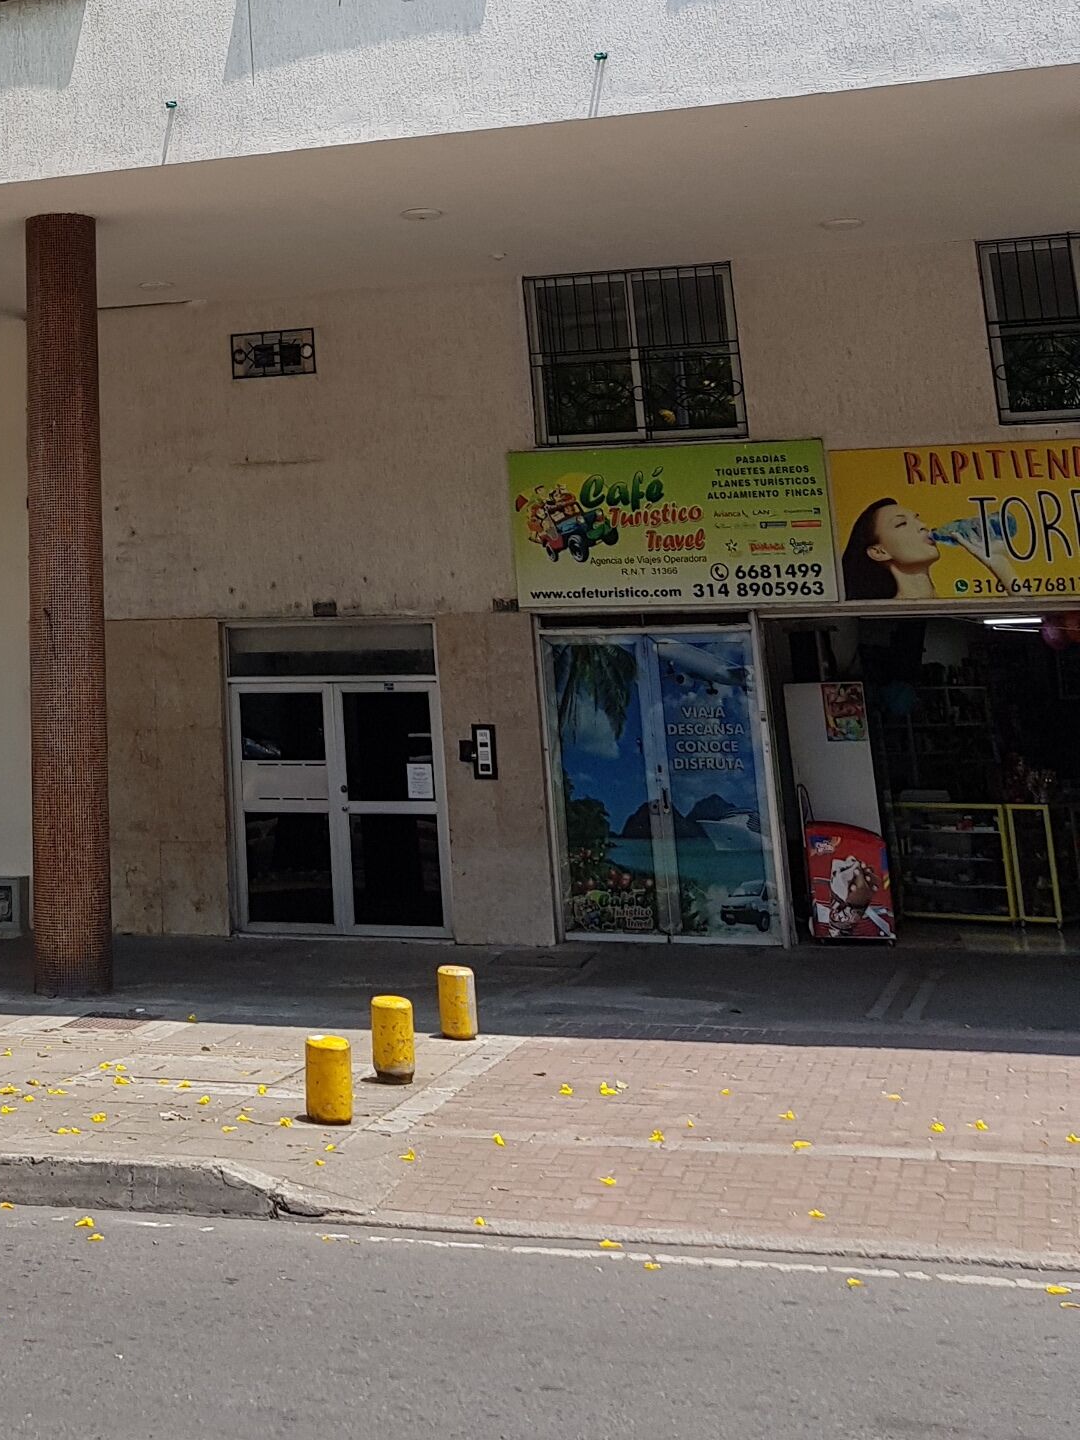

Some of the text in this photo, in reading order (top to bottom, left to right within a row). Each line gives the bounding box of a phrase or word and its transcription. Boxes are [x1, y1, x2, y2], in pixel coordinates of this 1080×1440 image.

[714, 466, 766, 476] TIQUETES
[580, 466, 664, 512] Café
[711, 476, 817, 488] PLANES TURÍSTICOS
[707, 487, 824, 500] ALOJAMIENTO FINCAS
[609, 502, 704, 528] Turístico
[646, 528, 706, 553] Travel
[590, 553, 708, 567] Agencia de Viajes Operadora
[735, 564, 822, 579] 6681499
[693, 581, 825, 598] 314 8905963
[973, 576, 1080, 594] 316 647681
[530, 586, 682, 600] www.cafeturistico.com
[681, 705, 726, 718] VIAJA
[667, 722, 745, 736] DESCANSA
[675, 740, 739, 753] CONOCE
[673, 757, 745, 771] DISFRUTA
